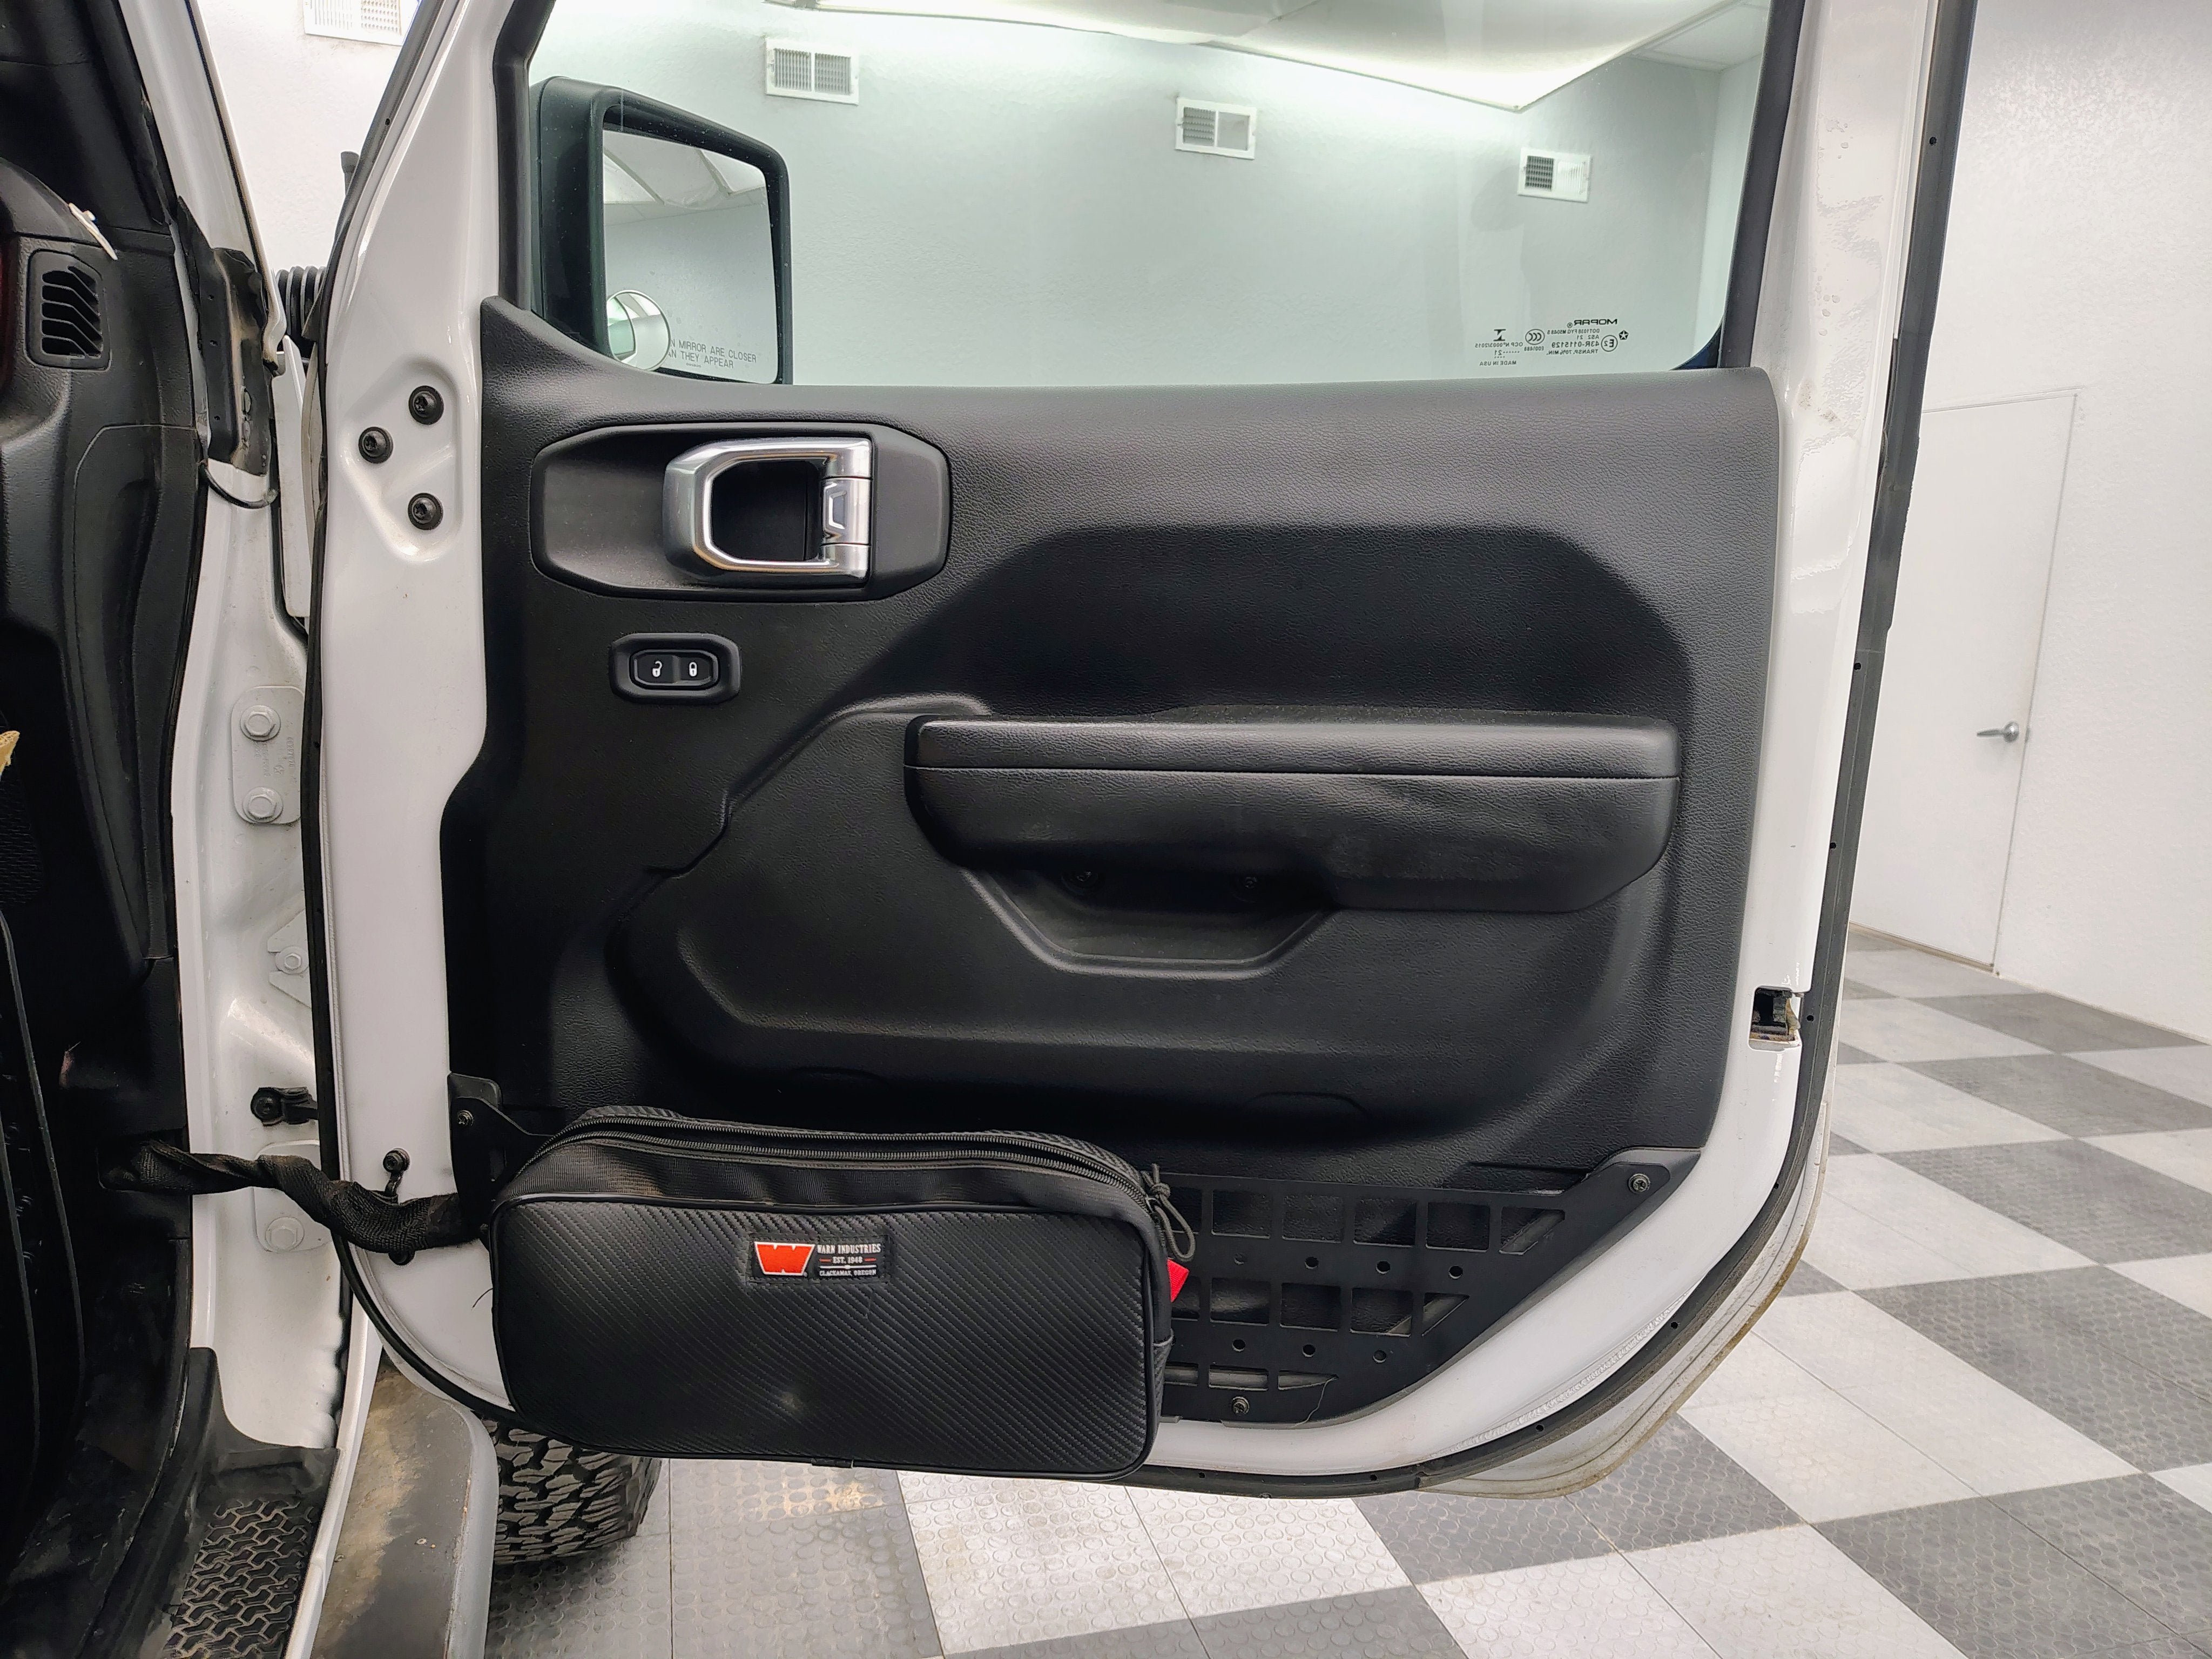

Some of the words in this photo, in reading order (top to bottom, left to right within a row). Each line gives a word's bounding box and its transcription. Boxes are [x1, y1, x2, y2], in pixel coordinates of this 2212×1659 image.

[670, 339, 675, 347] N
[679, 340, 706, 353] MIRROR
[710, 346, 725, 357] ARE
[729, 349, 757, 363] CLOSER
[680, 350, 699, 362] THEY
[704, 355, 734, 368] APPEAR
[817, 1244, 835, 1253] WARN
[838, 1244, 881, 1253] INDUSTRIES
